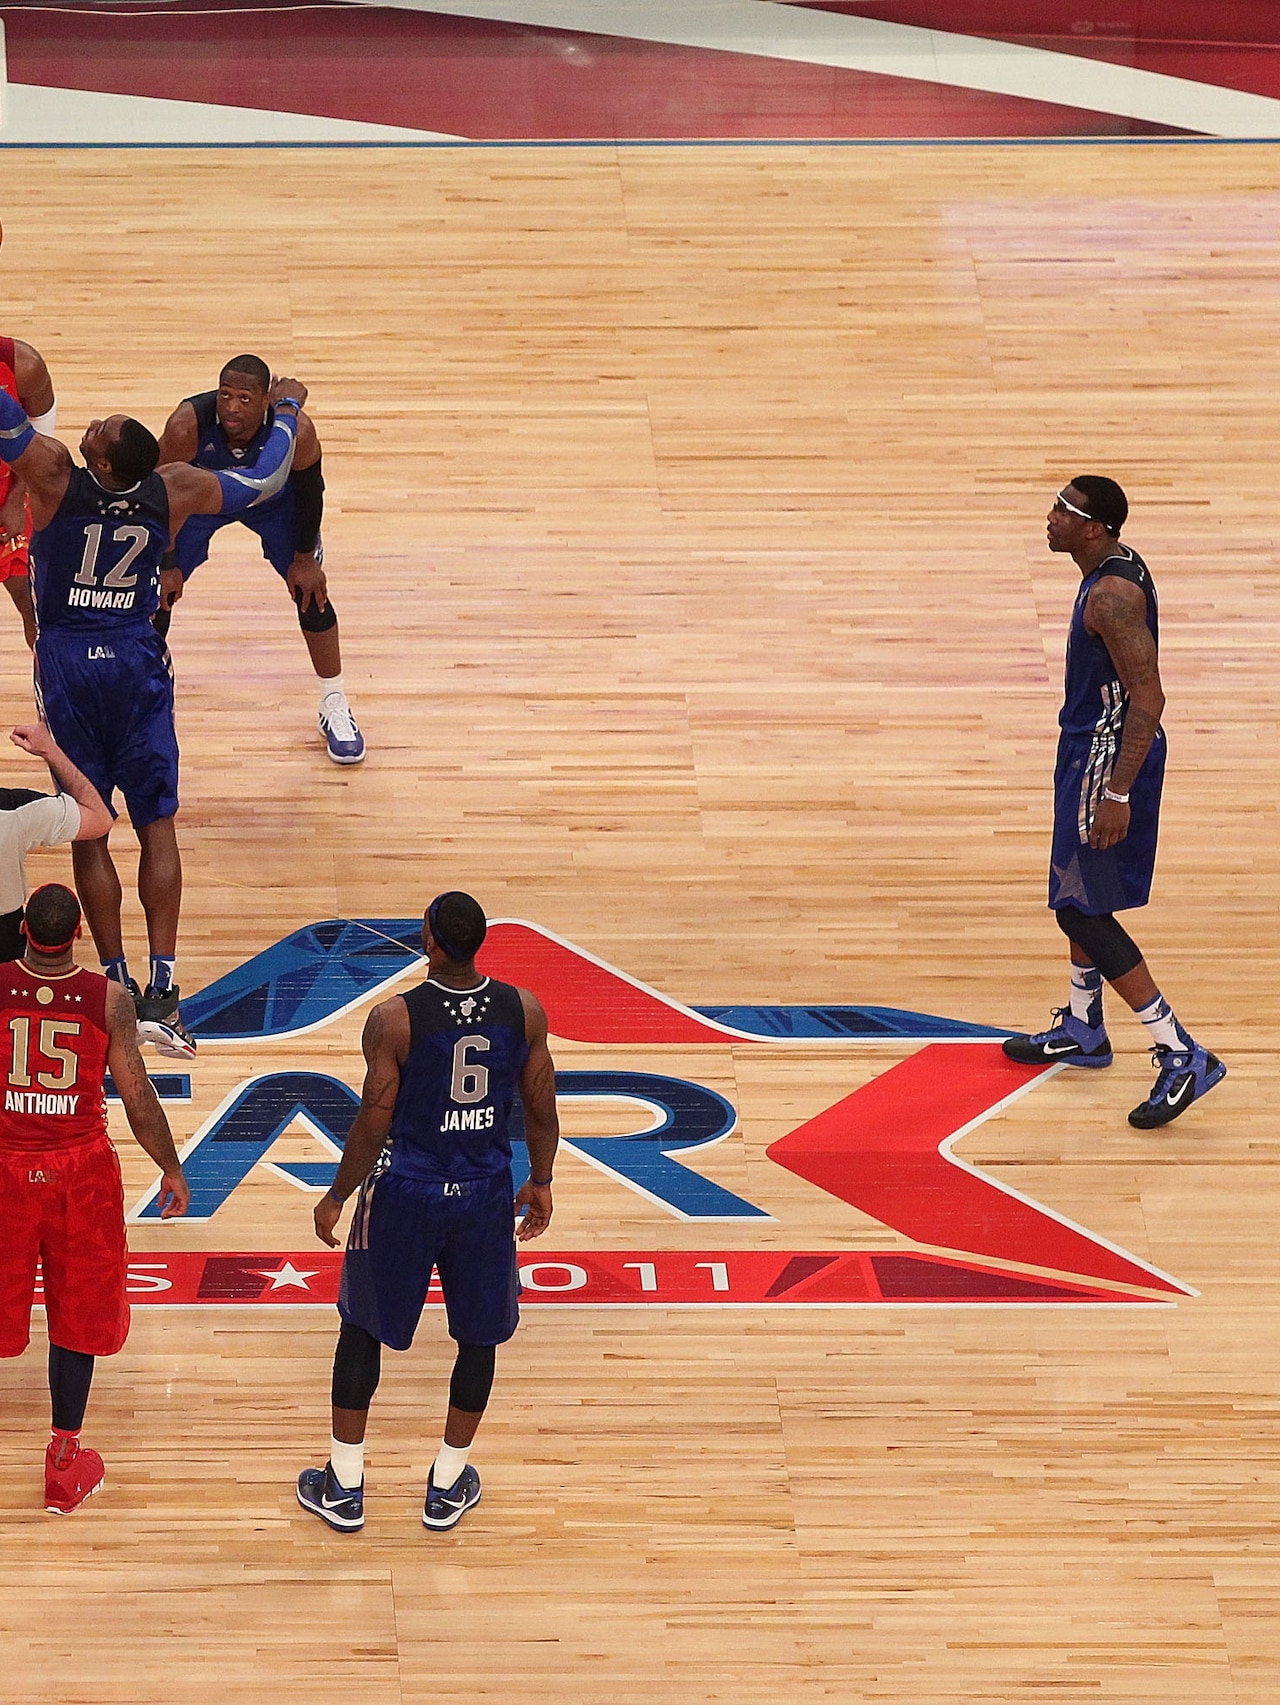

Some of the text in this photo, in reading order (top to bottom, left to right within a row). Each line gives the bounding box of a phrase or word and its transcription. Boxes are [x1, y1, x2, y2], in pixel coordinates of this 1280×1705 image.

[73, 523, 150, 588] 12
[67, 587, 136, 609] HOWARD
[8, 1017, 81, 1090] 15
[450, 1034, 490, 1104] 6
[4, 1090, 80, 1116] ANTHONY
[440, 1106, 495, 1133] JAMES
[428, 1262, 730, 1292] 011
